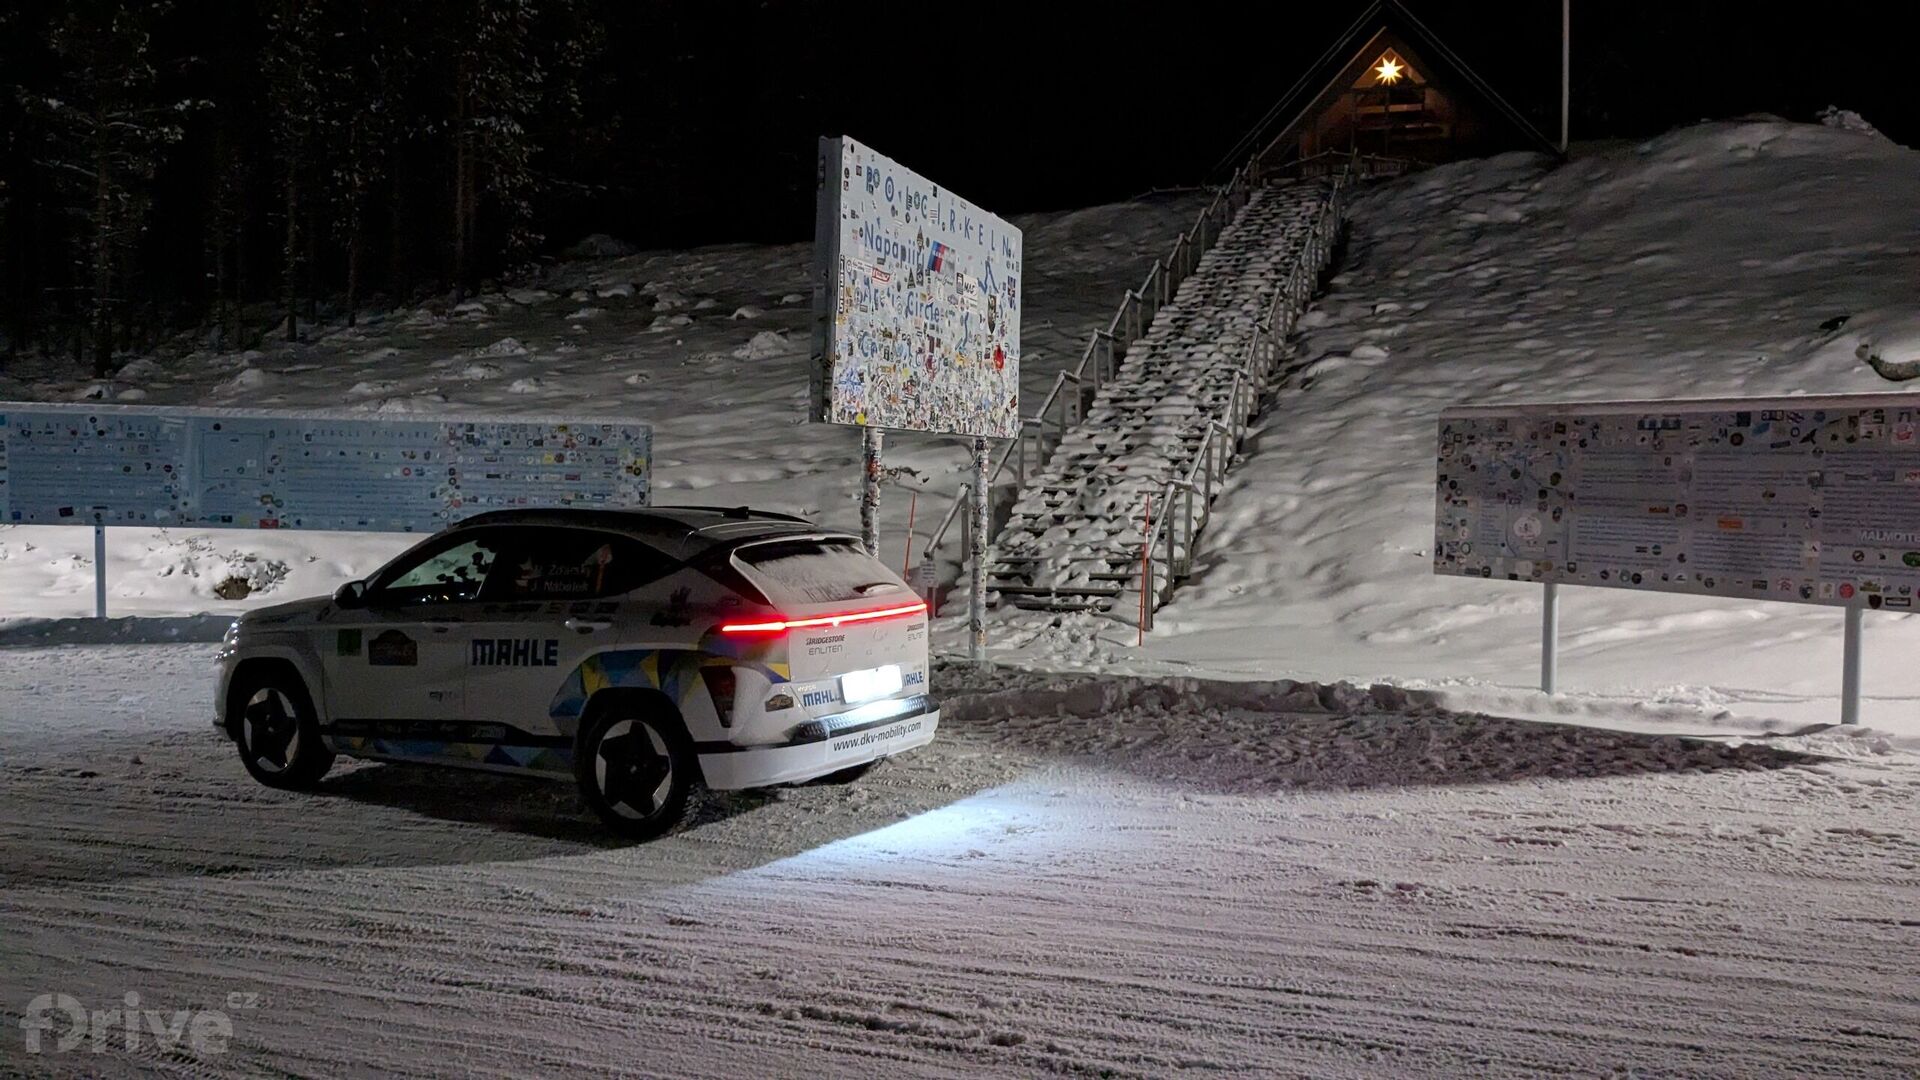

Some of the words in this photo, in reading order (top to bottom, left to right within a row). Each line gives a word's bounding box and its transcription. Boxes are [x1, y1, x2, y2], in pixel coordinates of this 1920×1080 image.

[471, 639, 558, 667] MAHLE
[808, 645, 843, 656] ENLITEN
[833, 722, 921, 752] www.dkv-mobility.com
